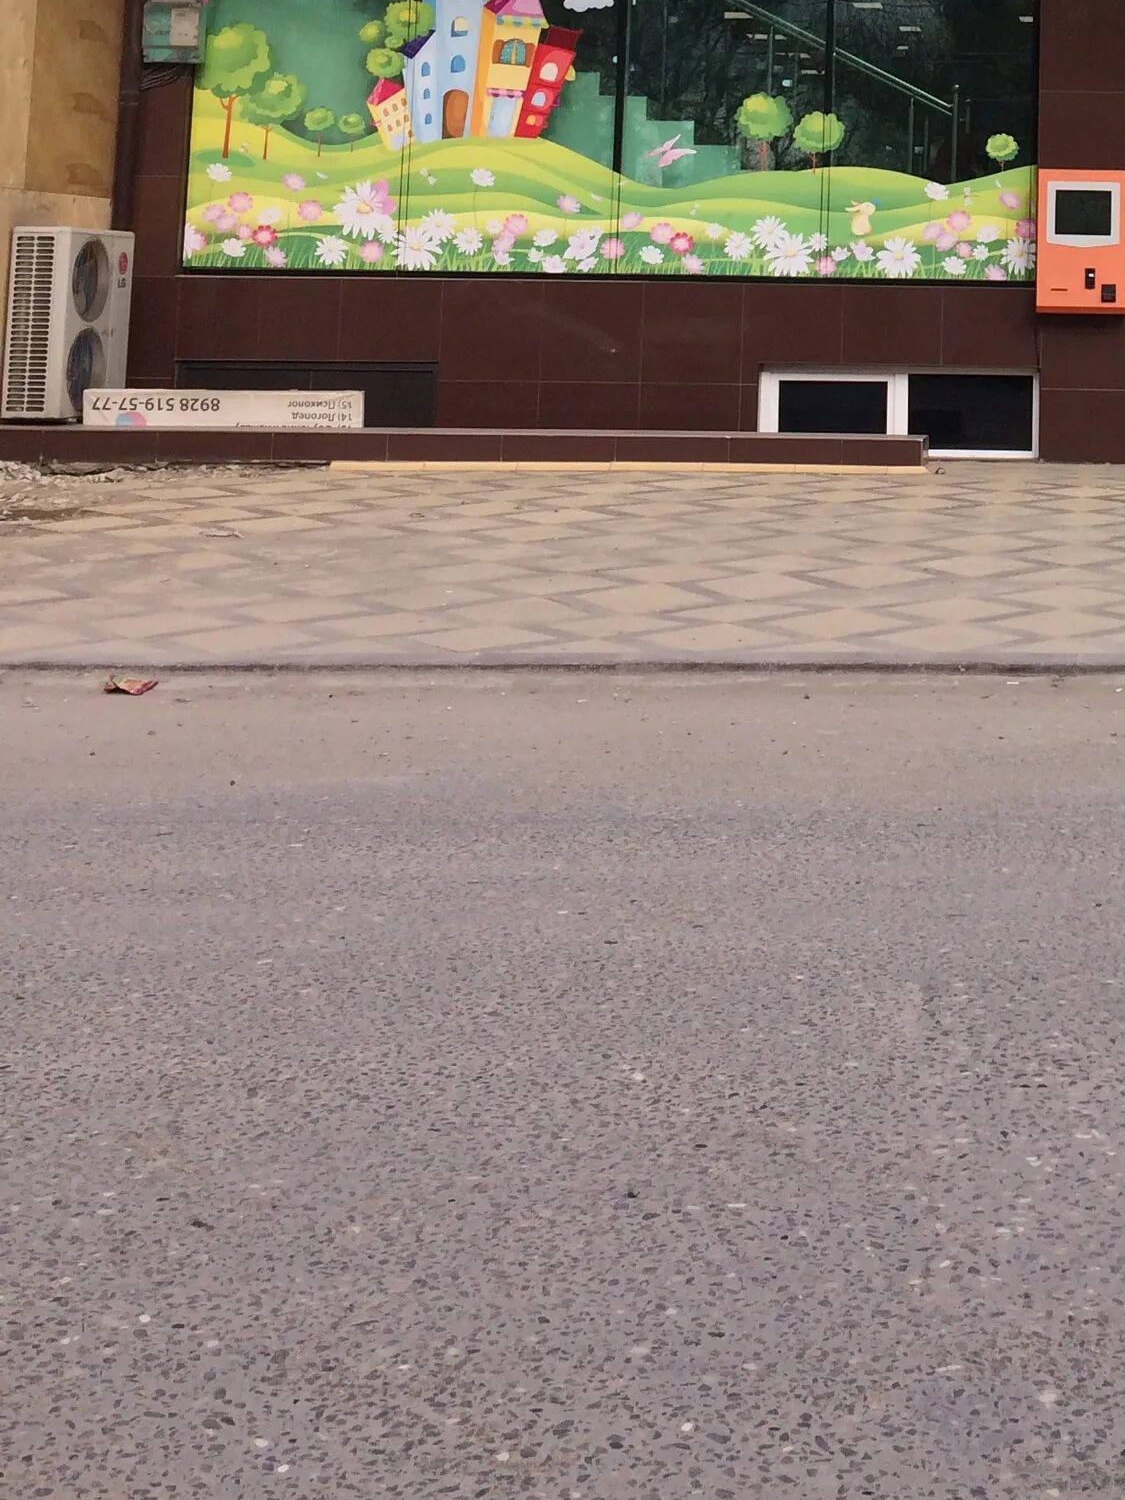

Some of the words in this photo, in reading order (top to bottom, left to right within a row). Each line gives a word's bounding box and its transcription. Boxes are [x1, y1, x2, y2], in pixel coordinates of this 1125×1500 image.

[117, 277, 127, 289] LG
[91, 396, 176, 412] 519-57-77
[179, 397, 221, 412] 8928
[287, 400, 336, 410] Психолог
[291, 411, 333, 422] Логопед
